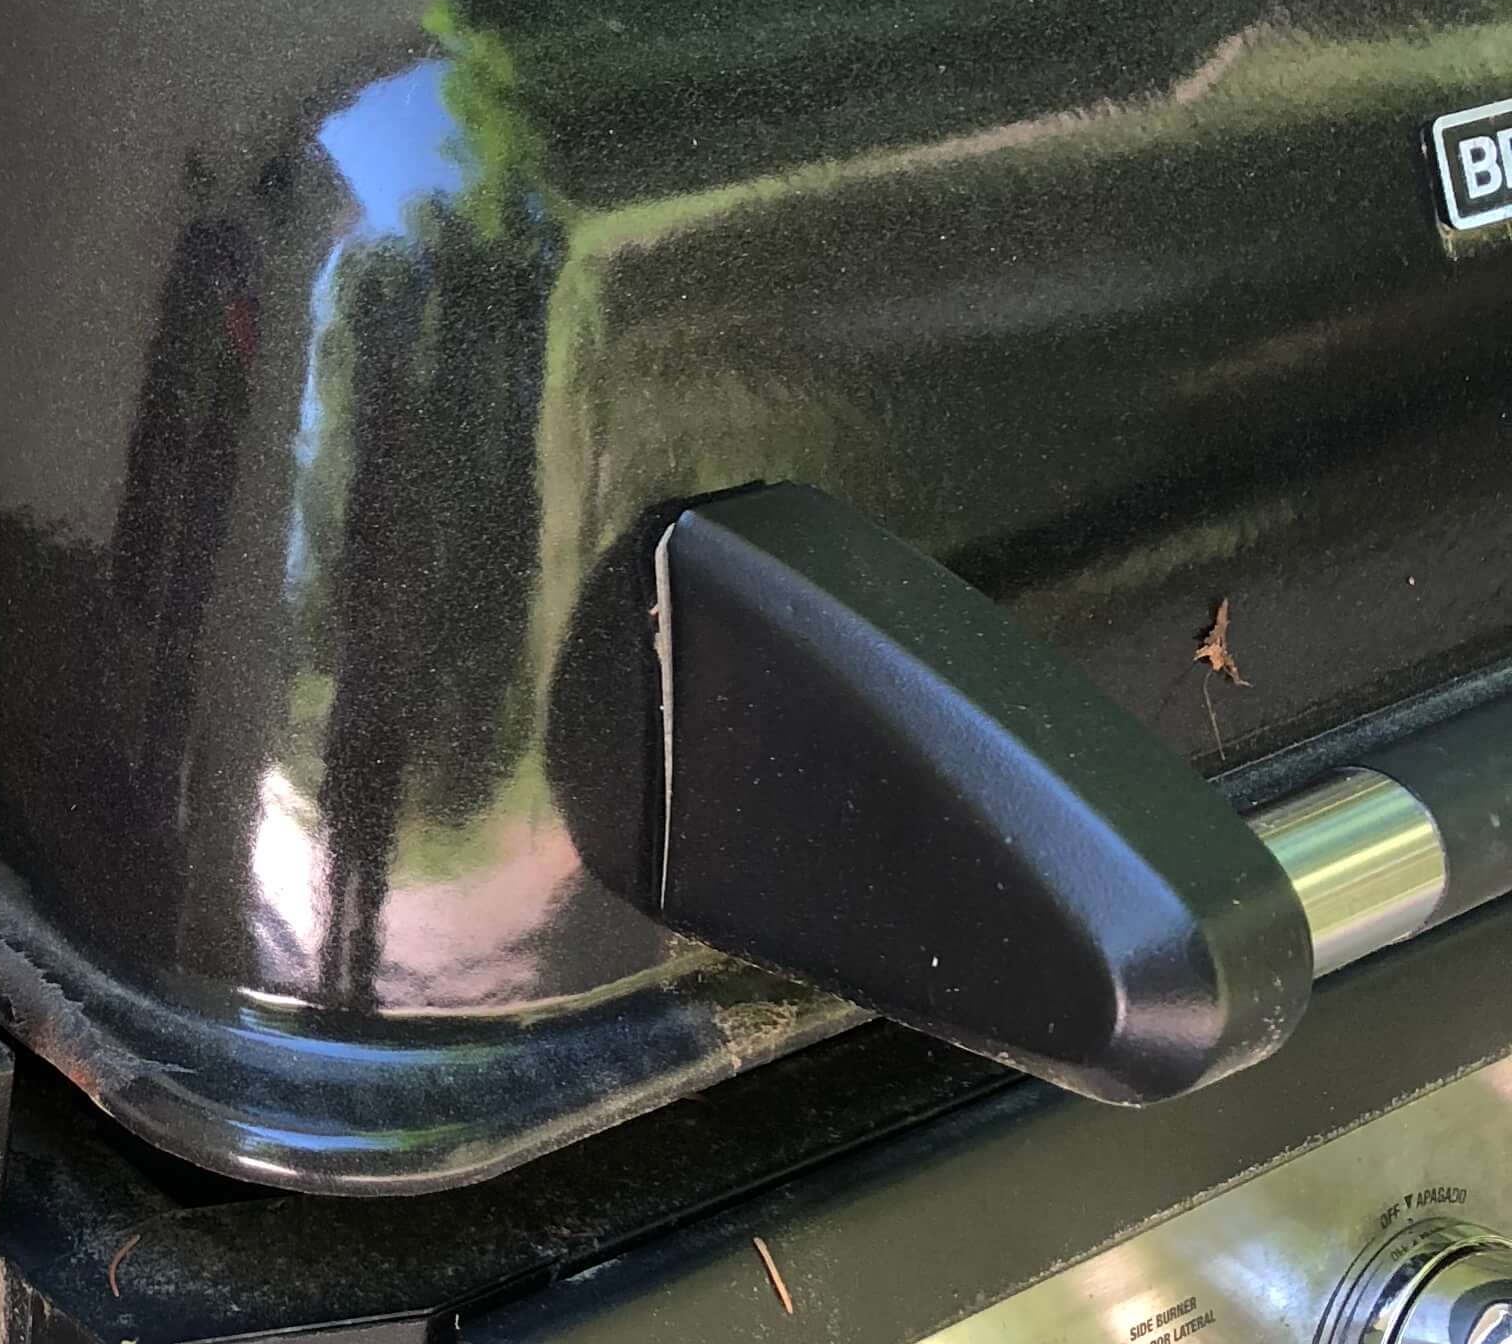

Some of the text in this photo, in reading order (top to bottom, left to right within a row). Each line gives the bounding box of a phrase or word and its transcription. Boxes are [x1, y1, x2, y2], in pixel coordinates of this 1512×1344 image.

[1379, 1187, 1467, 1230] OFF APAGADO
[1129, 1296, 1197, 1341] SIDE BURNER
[1173, 1309, 1216, 1341] LATERAL
